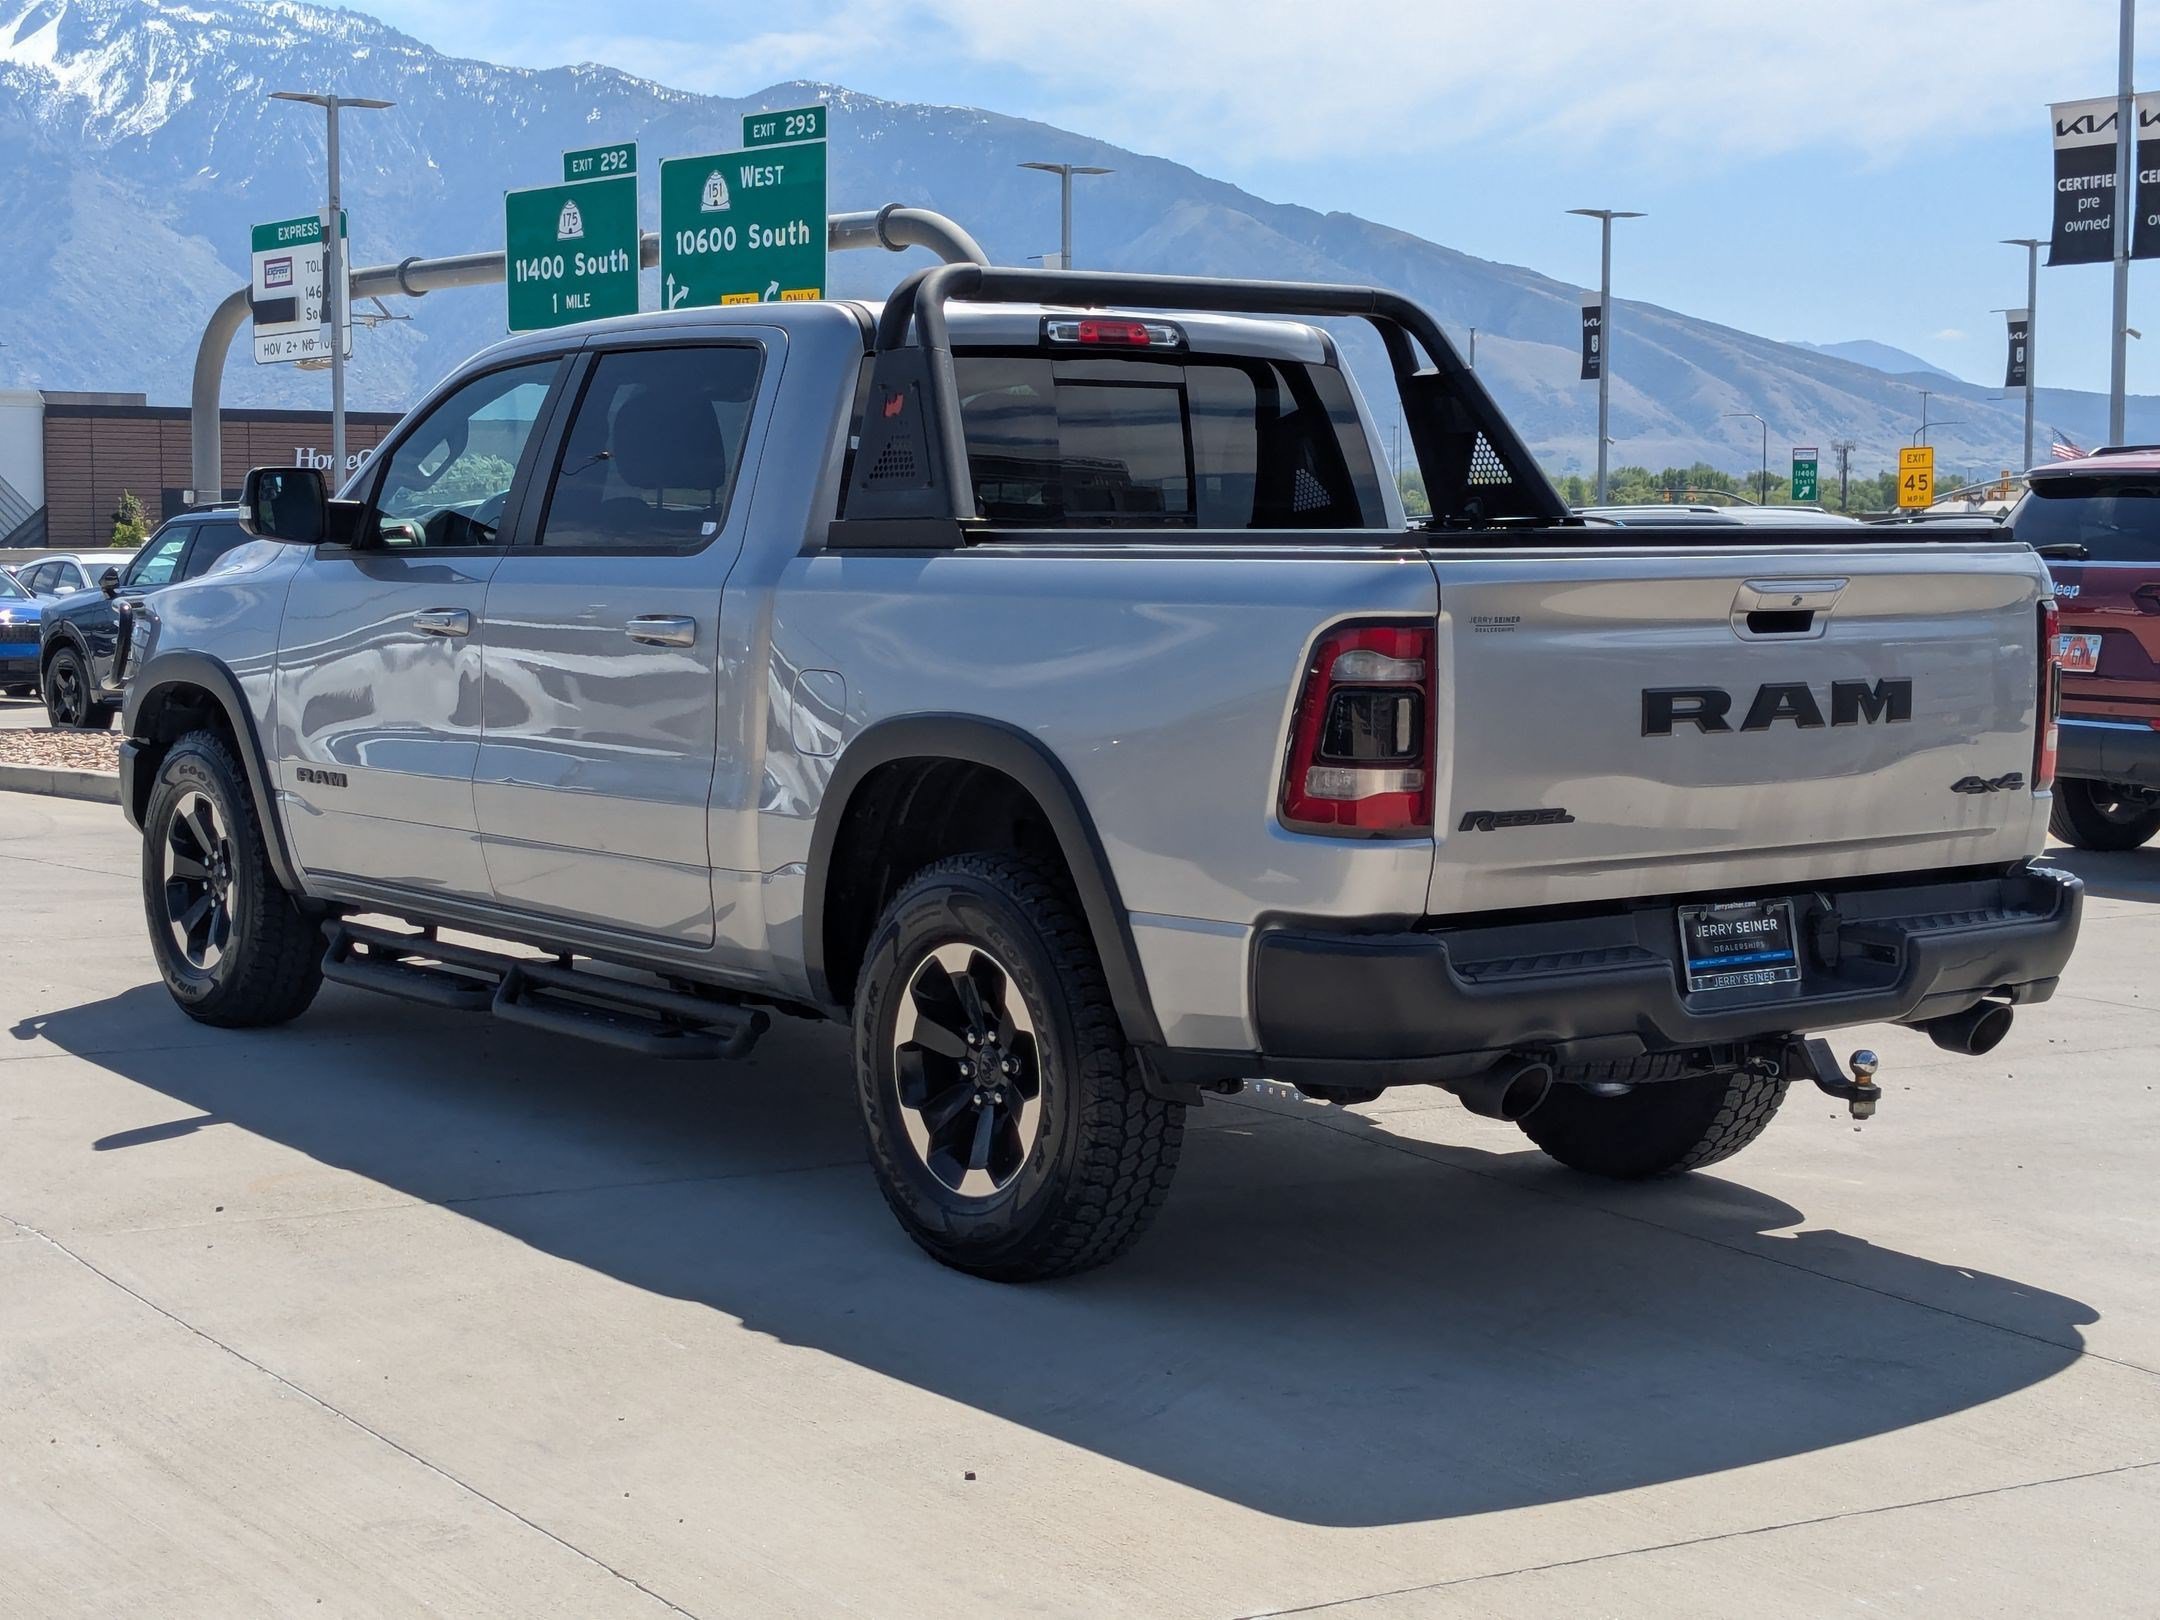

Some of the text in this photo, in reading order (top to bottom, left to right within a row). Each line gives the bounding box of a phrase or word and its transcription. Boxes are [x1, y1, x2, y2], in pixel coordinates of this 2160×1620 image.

[753, 113, 816, 138] EXIT 293
[572, 150, 628, 173] EXIT 292
[740, 165, 784, 189] WEST
[708, 182, 723, 198] 151
[2078, 196, 2100, 213] pre
[562, 212, 578, 227] 175
[2064, 214, 2111, 233] owned
[278, 221, 320, 241] EXPRESS
[676, 219, 810, 255] 10600 South
[305, 259, 323, 274] TOL
[516, 248, 629, 283] 11400 South
[305, 286, 322, 300] 146
[552, 293, 591, 314] 1 MILE
[264, 341, 281, 356] HOV
[287, 341, 298, 353] 2+
[302, 338, 315, 351] NO
[1907, 453, 1926, 463] EXIT
[1904, 474, 1928, 491] 45
[1641, 676, 1912, 737] RAM
[296, 766, 348, 788] RAM
[1696, 918, 1778, 938] JERRY SEINER
[1713, 941, 1765, 953] DEALERSHIPS
[1713, 971, 1776, 988] JERRY SEINER
